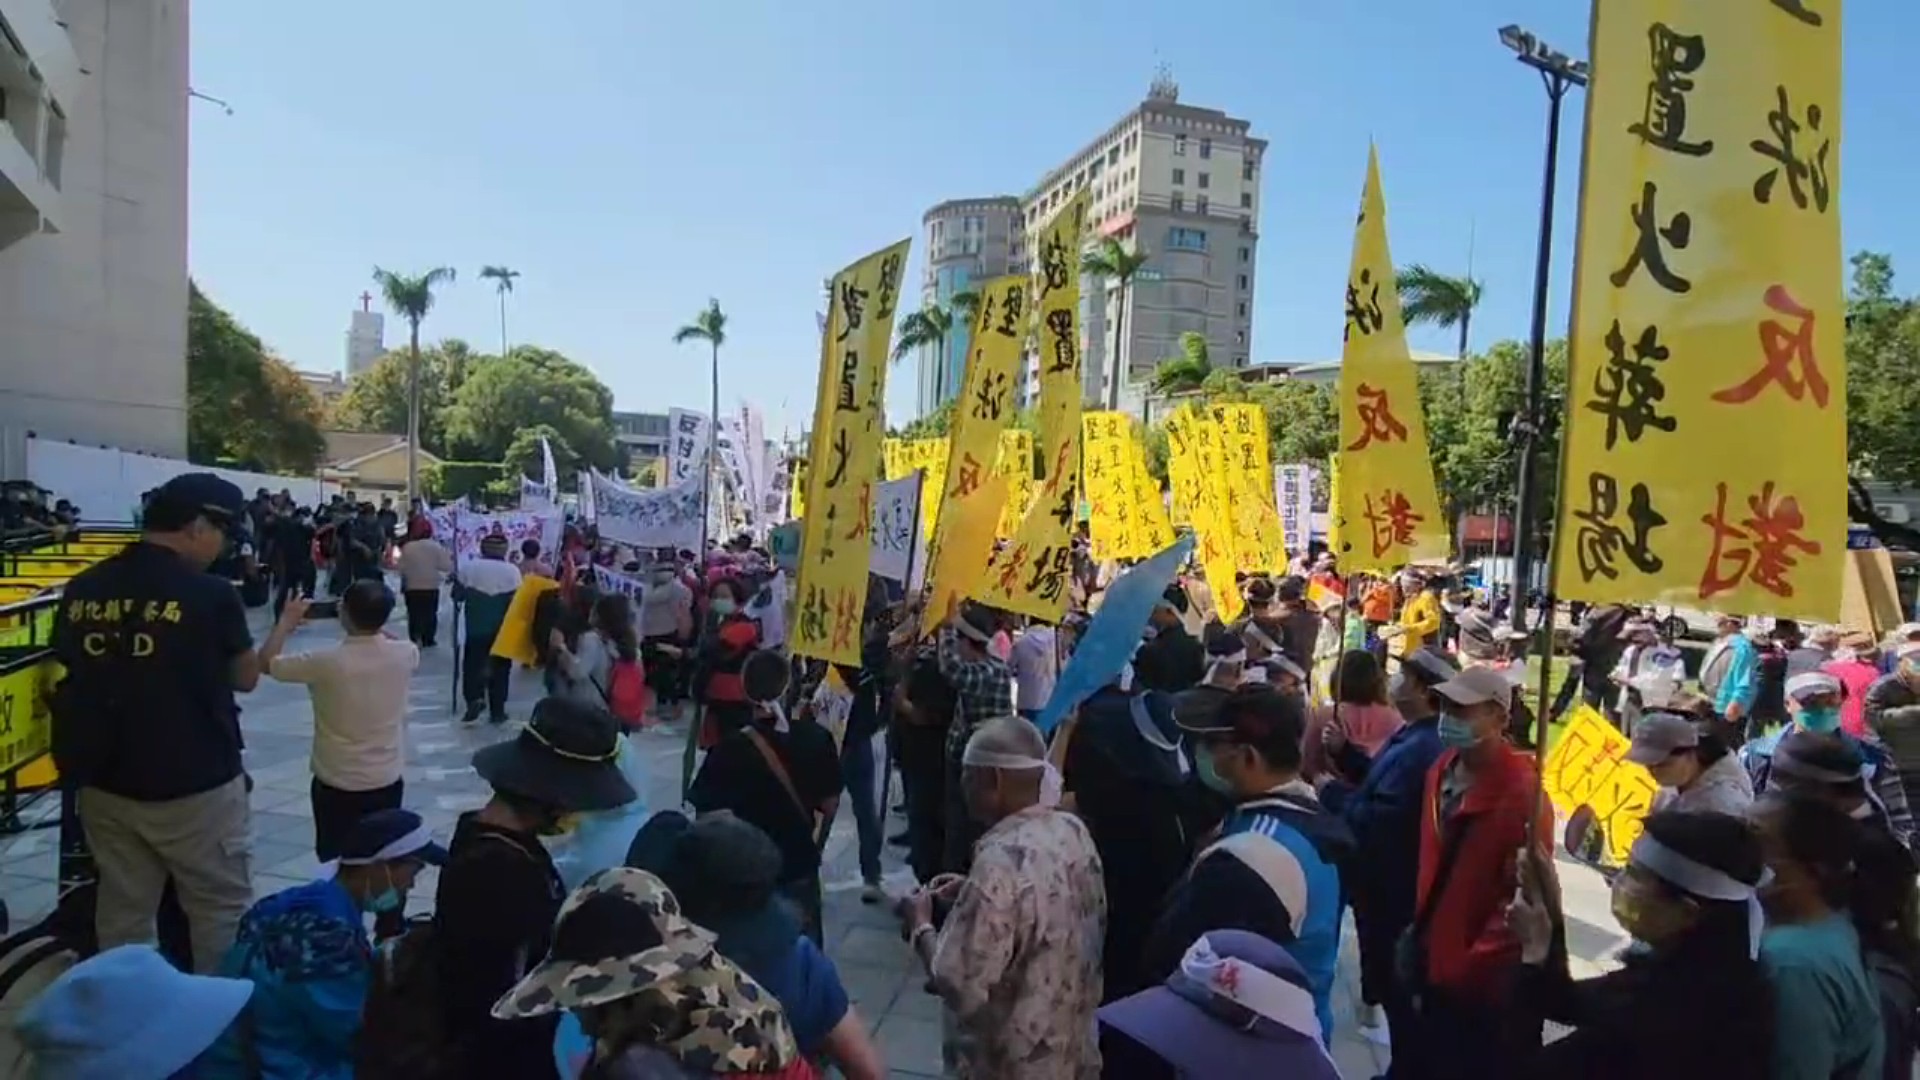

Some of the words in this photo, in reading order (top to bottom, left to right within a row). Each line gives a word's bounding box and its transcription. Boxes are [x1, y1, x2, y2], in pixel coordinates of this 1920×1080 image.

[69, 599, 183, 623] 彰化縣察局
[83, 632, 155, 657] CD
